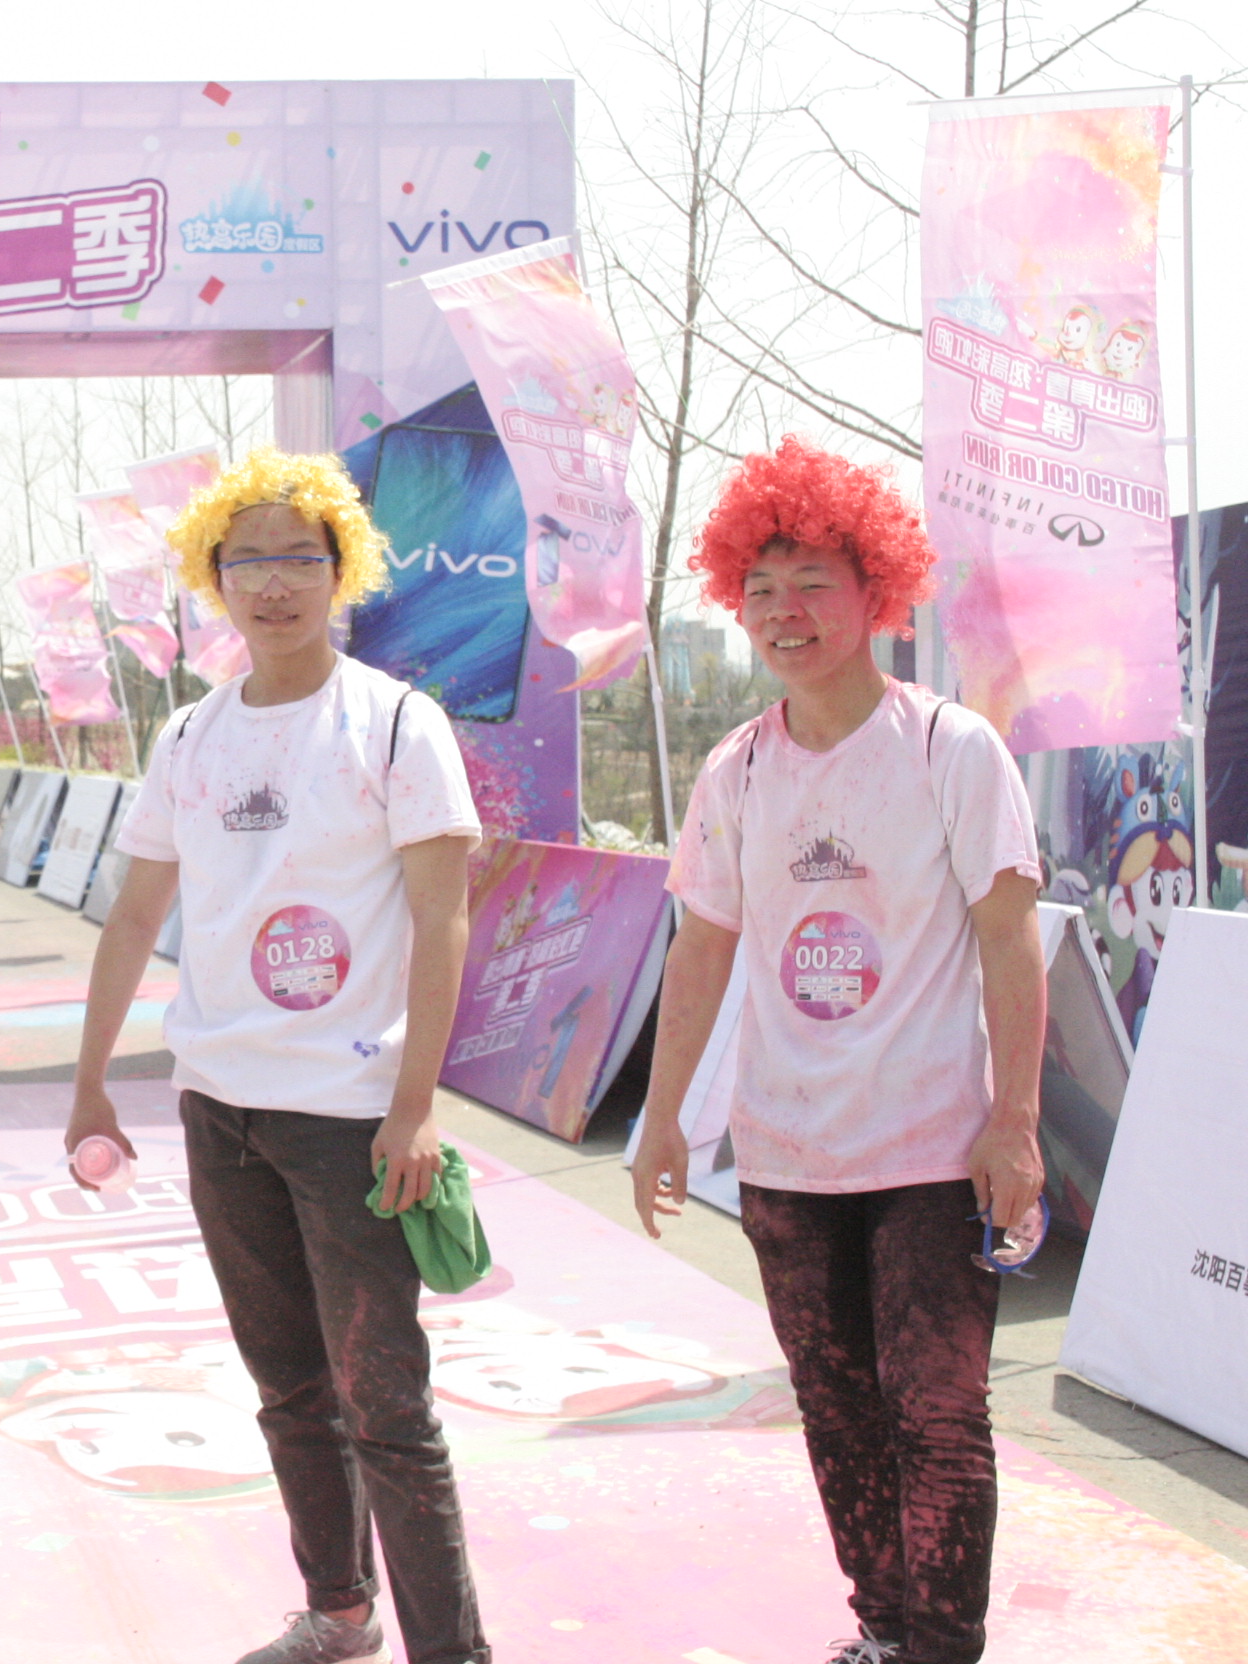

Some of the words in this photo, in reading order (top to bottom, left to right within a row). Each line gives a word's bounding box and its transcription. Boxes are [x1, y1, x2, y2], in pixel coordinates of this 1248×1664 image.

[387, 208, 550, 254] vivo
[384, 542, 518, 578] vivo
[266, 934, 336, 967] 0128
[795, 945, 864, 970] 0022
[1190, 1248, 1248, 1297] 沈阳百
